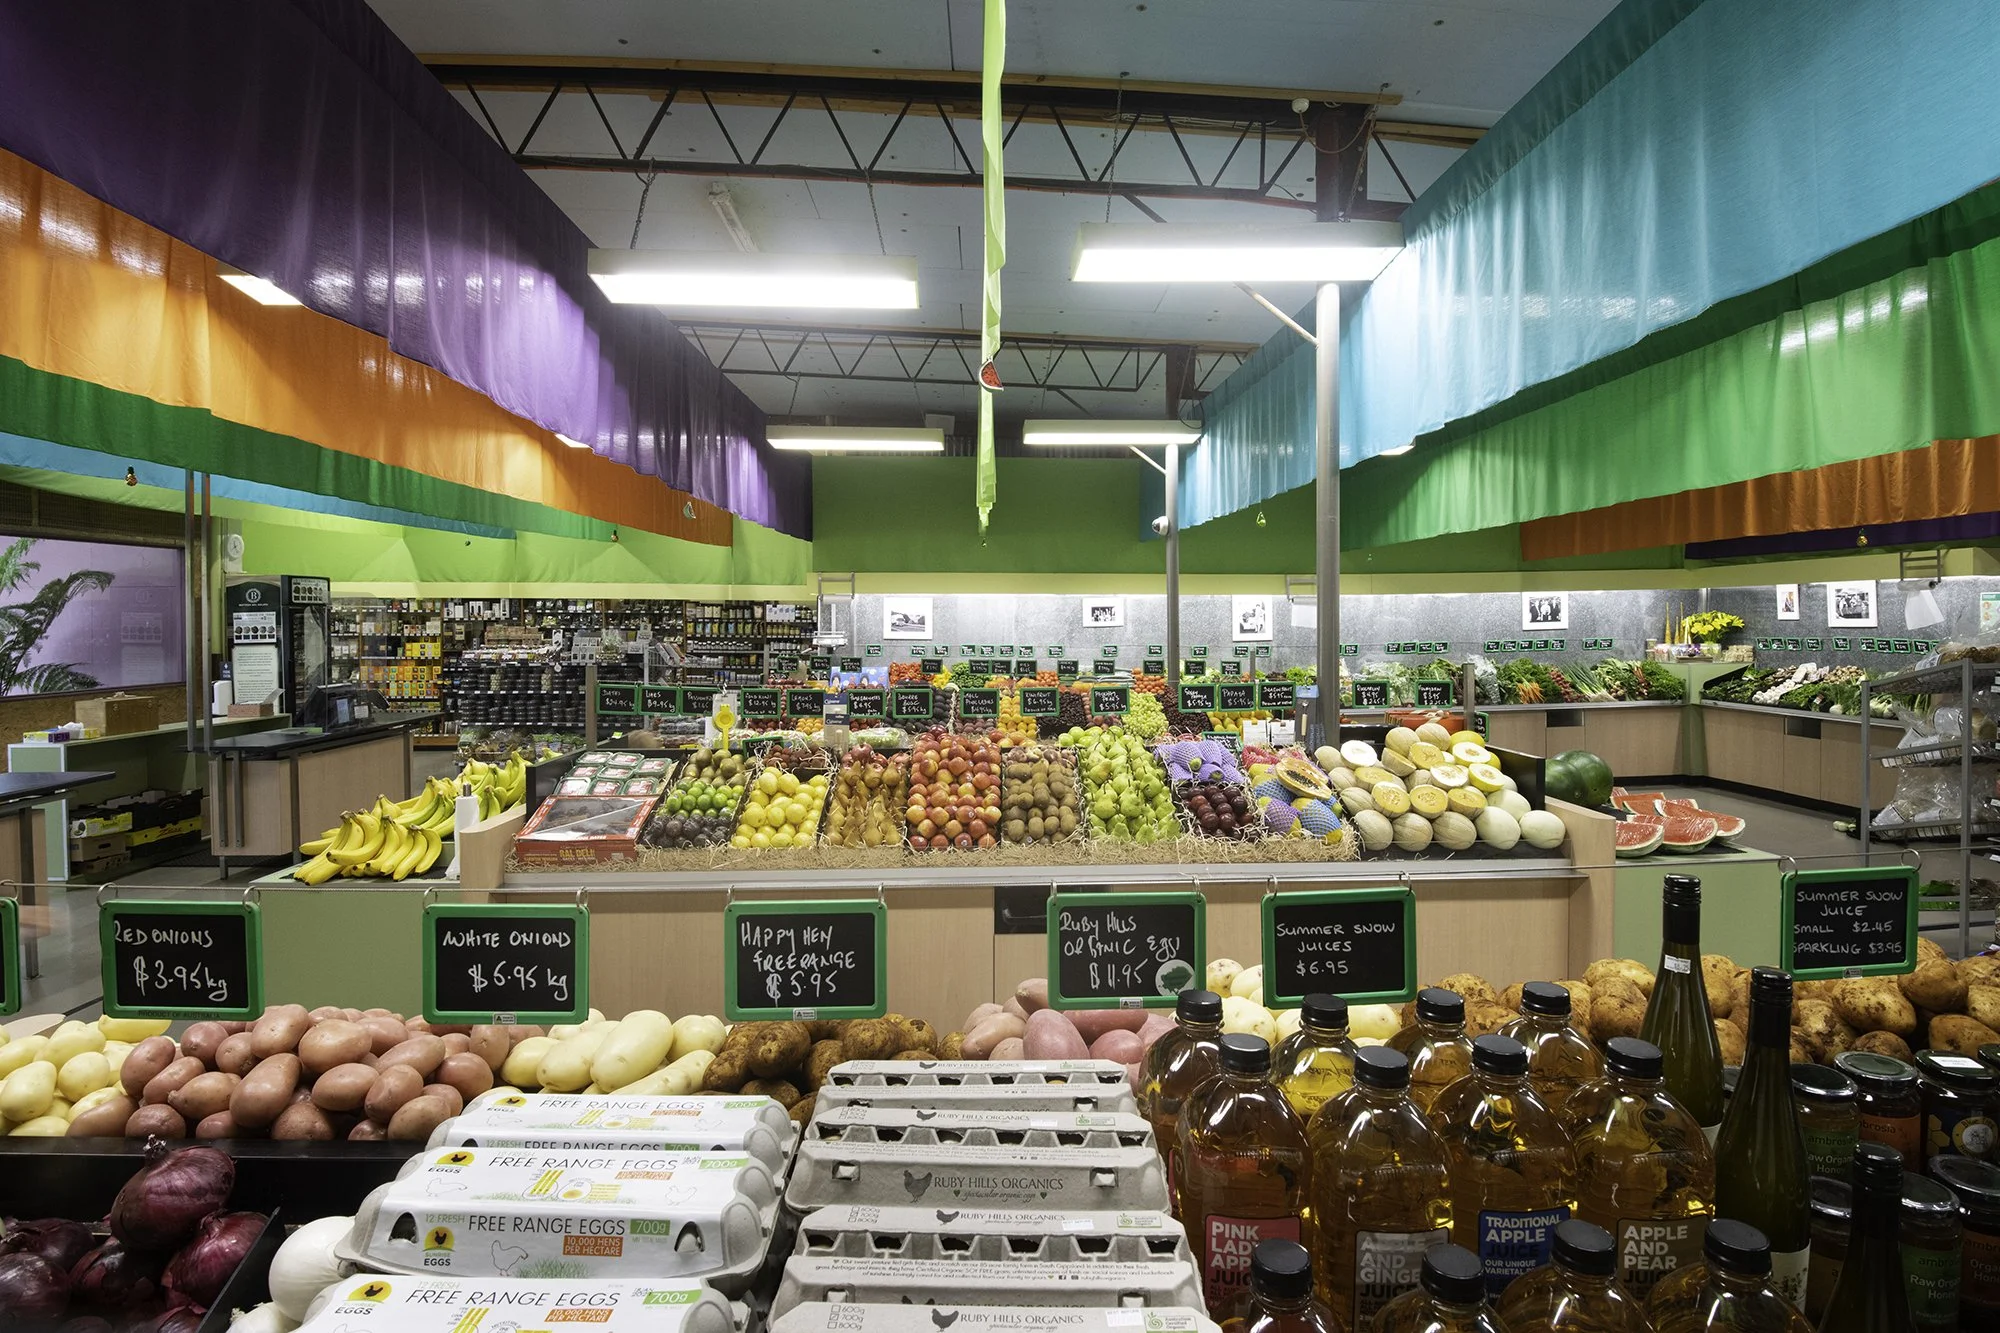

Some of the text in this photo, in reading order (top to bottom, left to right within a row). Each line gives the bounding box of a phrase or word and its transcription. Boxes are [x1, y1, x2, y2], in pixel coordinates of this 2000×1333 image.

[1796, 890, 1903, 902] SUMMER SNOW
[1820, 905, 1868, 917] JUICE
[1276, 923, 1396, 937] SUMMER SNOW
[1793, 920, 1893, 934] SMALL $2.45
[152, 929, 214, 948] ONIONS
[443, 929, 500, 948] WHITE
[741, 921, 833, 956] HAPPY HEN
[1297, 941, 1352, 953] JUICES
[1793, 942, 1902, 955] SPARKLING $3.95
[1089, 959, 1148, 989] $11.95
[1296, 960, 1349, 976] $6.95
[205, 966, 228, 1001] kg
[547, 968, 569, 1001] kg
[540, 1100, 581, 1108] FREE
[586, 1101, 650, 1109] RANGE
[489, 1157, 537, 1167] FREE
[542, 1158, 615, 1169] RANGE
[622, 1159, 677, 1170] EGGS
[705, 1160, 737, 1168] 700g
[934, 1177, 1064, 1190] RUBY HILLS ORGANICS
[425, 1214, 465, 1223] 12 FRESH
[468, 1215, 667, 1236] FREE RANGE EGGS 700g
[1485, 1214, 1561, 1229] TRADITIONAL
[1212, 1221, 1259, 1240] PINK
[1485, 1228, 1546, 1243] APPLE
[1624, 1225, 1688, 1240] APPLE
[597, 1238, 621, 1247] HENS
[1624, 1240, 1669, 1255] AND
[565, 1245, 620, 1256] PER HECTARE
[1485, 1244, 1540, 1258] JUICE
[424, 1258, 451, 1267] EGGS
[1211, 1254, 1252, 1271] APP
[1360, 1252, 1405, 1268] AND
[1505, 1260, 1536, 1268] UNIQUE
[1624, 1255, 1677, 1270] PEAR
[1360, 1268, 1420, 1283] GINGE
[1485, 1267, 1524, 1275] VARIETAL
[430, 1281, 460, 1289] FRESH
[405, 1290, 462, 1304] FREE
[465, 1291, 550, 1306] RANGE
[555, 1292, 621, 1306] EGGS
[650, 1292, 688, 1304] 700g
[334, 1307, 373, 1315] EGGS
[841, 1306, 865, 1314] 600g
[960, 1314, 1084, 1324] RUBY HILLS ORGANICS
